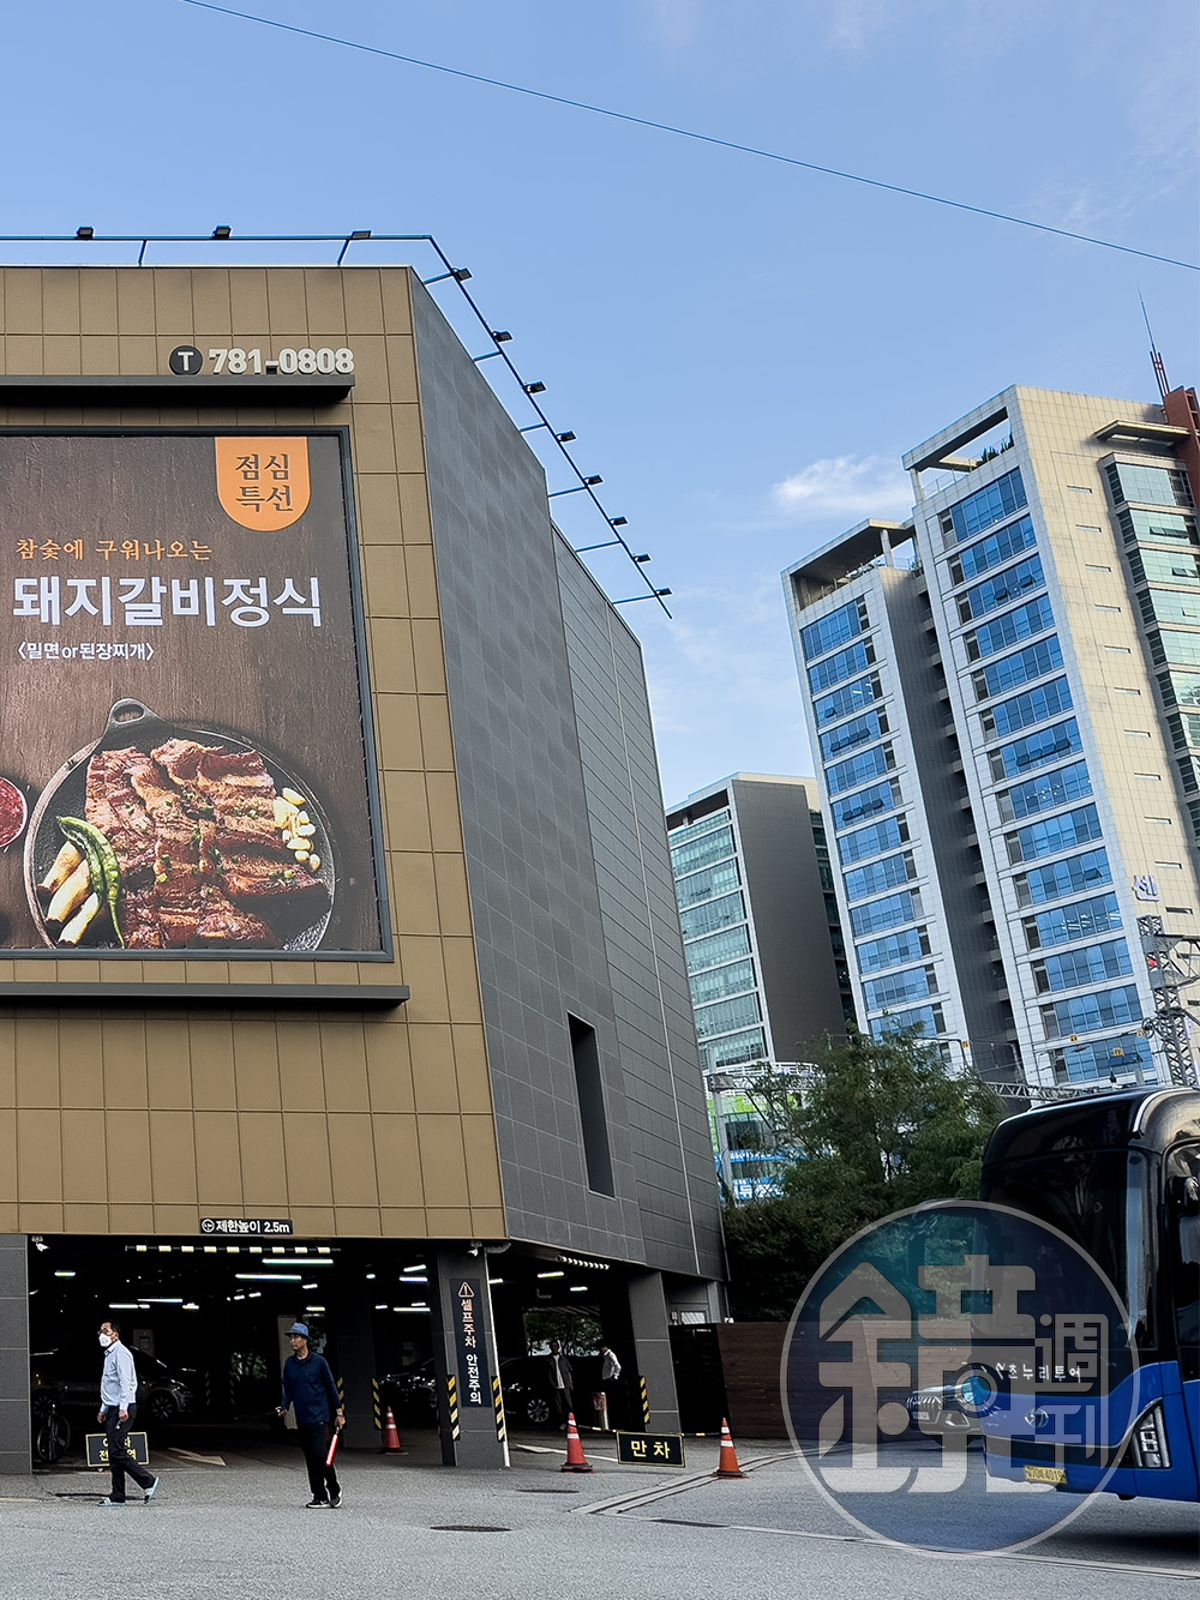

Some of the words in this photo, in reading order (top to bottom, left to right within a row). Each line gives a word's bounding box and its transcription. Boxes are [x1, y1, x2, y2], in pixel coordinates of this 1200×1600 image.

[209, 347, 355, 375] 781-0808
[235, 453, 289, 480] 점심
[236, 485, 293, 512] 특선
[16, 539, 85, 561] 참숯에
[96, 539, 212, 561] 구워나오는
[13, 576, 321, 627] 돼지갈비정식
[215, 1219, 261, 1233] 제한높이
[263, 1221, 290, 1233] 2.5m
[461, 1299, 476, 1348] 셀프주차
[466, 1354, 482, 1404] 안전주의
